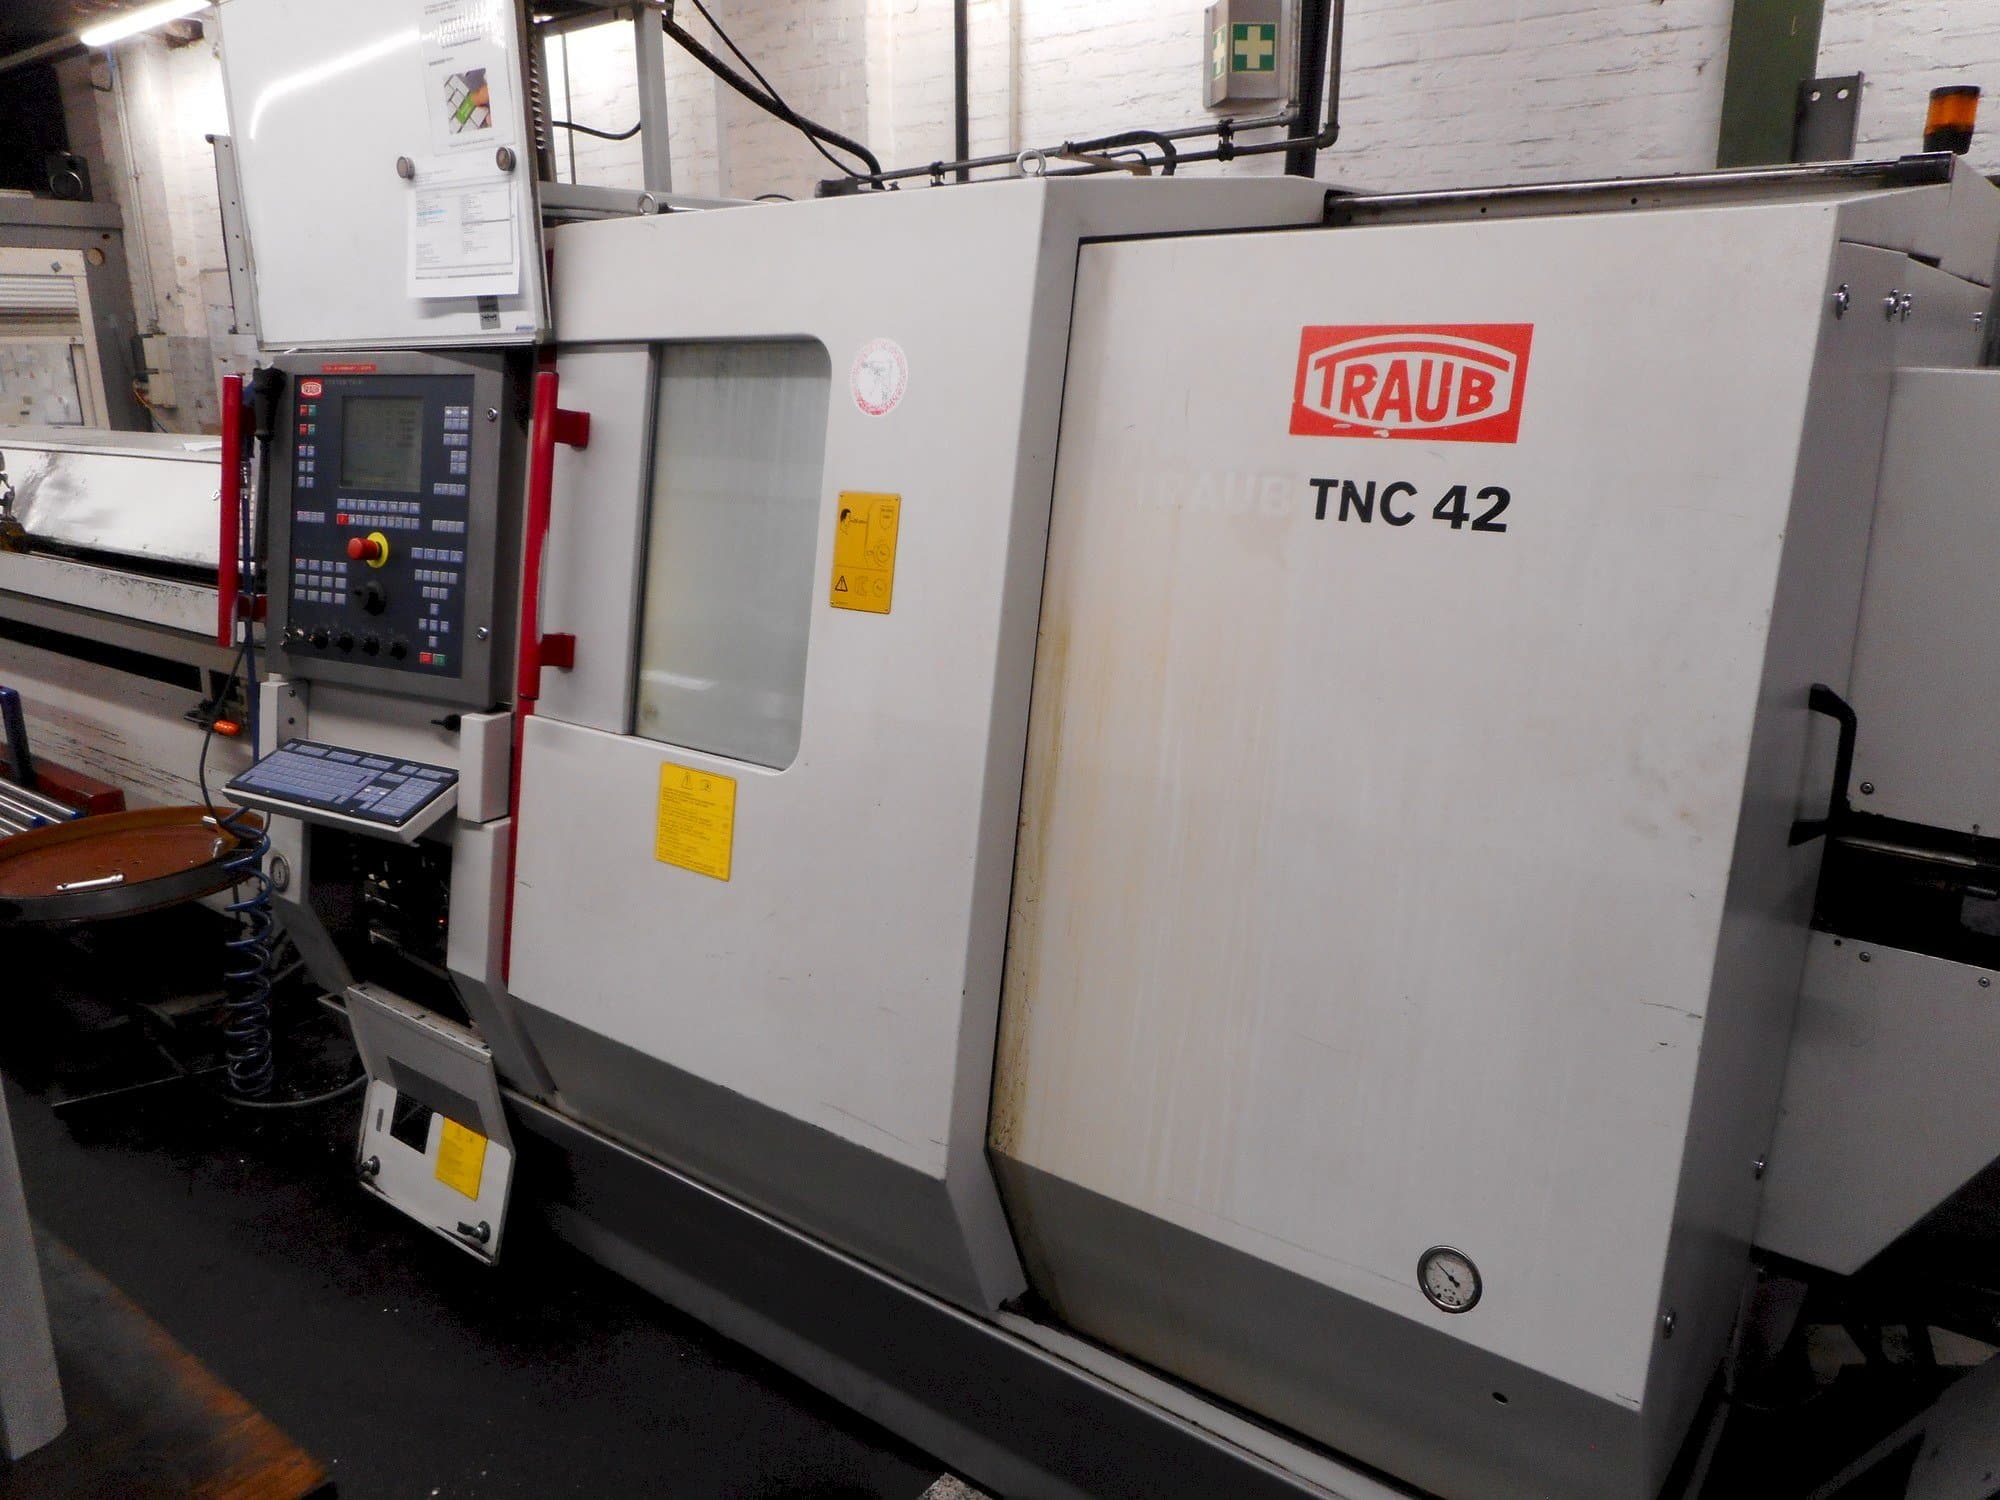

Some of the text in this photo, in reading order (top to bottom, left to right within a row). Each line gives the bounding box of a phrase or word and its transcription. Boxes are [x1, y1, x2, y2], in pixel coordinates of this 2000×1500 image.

[1313, 340, 1511, 424] TRAUB
[1309, 478, 1511, 533] TNC 42
